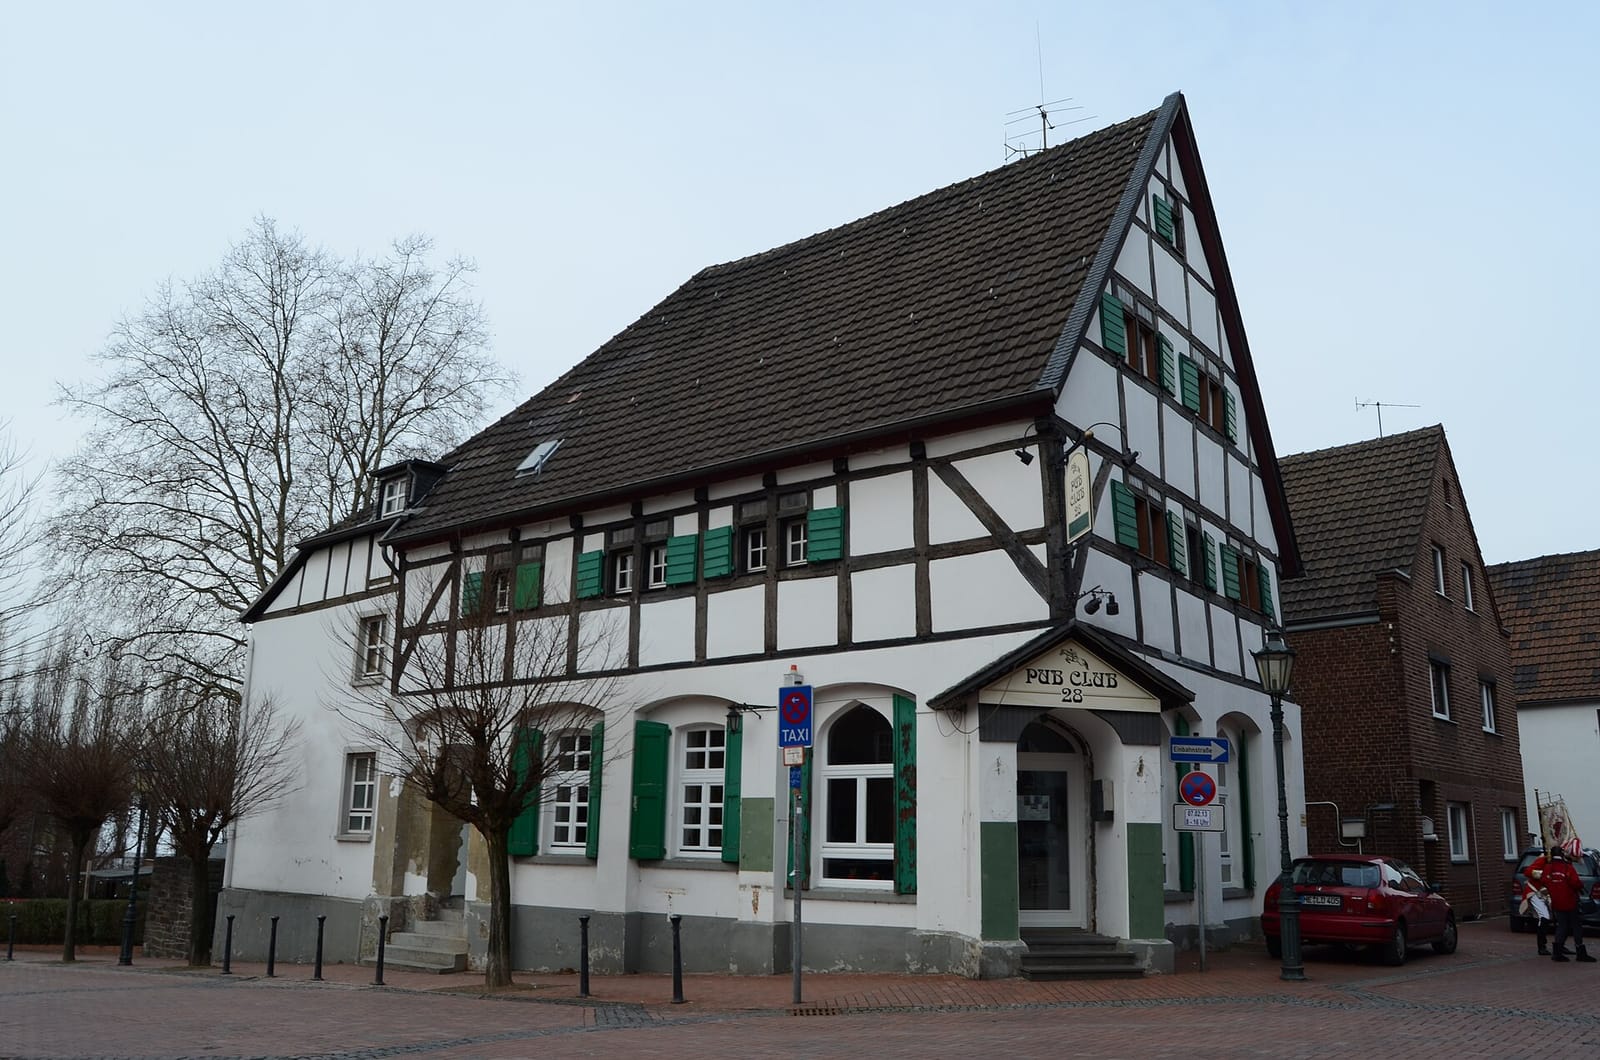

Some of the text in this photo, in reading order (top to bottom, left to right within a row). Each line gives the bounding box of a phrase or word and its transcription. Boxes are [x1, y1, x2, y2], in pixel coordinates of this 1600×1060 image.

[1025, 668, 1118, 688] PUB CLUB
[1061, 688, 1083, 703] 28
[781, 728, 809, 742] TAXI
[1174, 746, 1213, 754] Einbahnstraße
